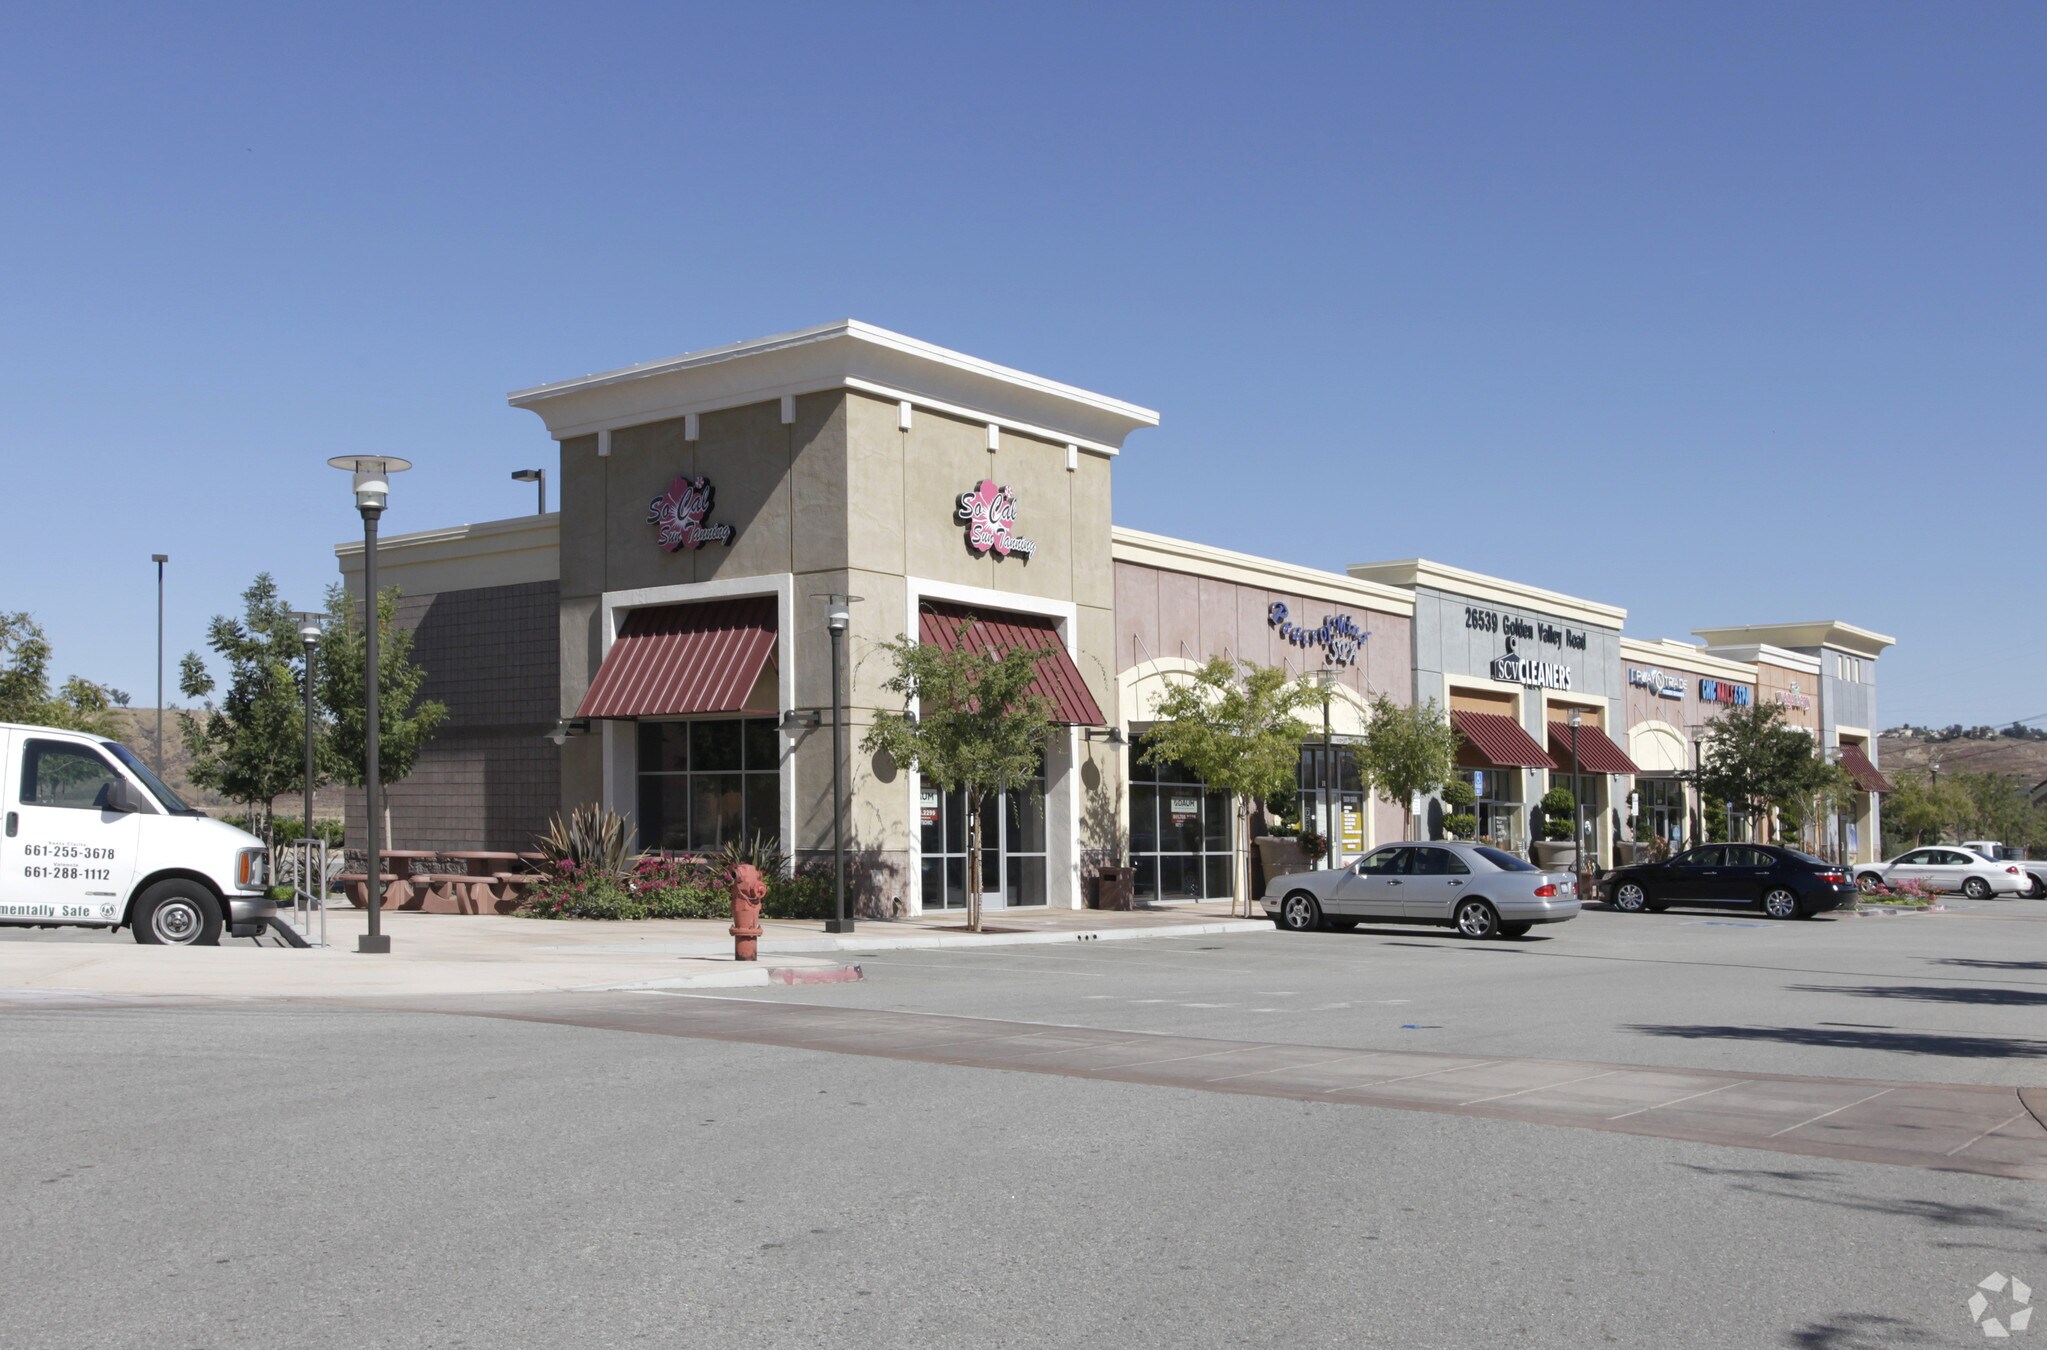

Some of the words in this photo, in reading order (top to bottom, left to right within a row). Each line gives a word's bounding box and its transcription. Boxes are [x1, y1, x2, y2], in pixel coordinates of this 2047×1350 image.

[646, 495, 671, 525] So
[677, 486, 711, 521] Cal
[959, 492, 982, 519] So
[988, 494, 1018, 524] Cal
[657, 525, 682, 546] Sun
[684, 521, 732, 547] Tanning
[971, 525, 994, 544] Sun
[996, 527, 1037, 559] Tanning
[1465, 606, 1499, 633] 26539
[1503, 614, 1534, 640] Golden
[1537, 622, 1562, 650] Valley
[1565, 628, 1586, 651] Road
[1328, 640, 1360, 664] SPA
[1498, 660, 1520, 680] SCV
[1518, 658, 1572, 690] CLEANERS
[1664, 675, 1688, 690] TRADE
[1716, 681, 1734, 704] NAILS
[24, 844, 115, 860] 661-255-3678
[24, 866, 110, 880] 661-288-1112
[62, 905, 90, 917] Safe
